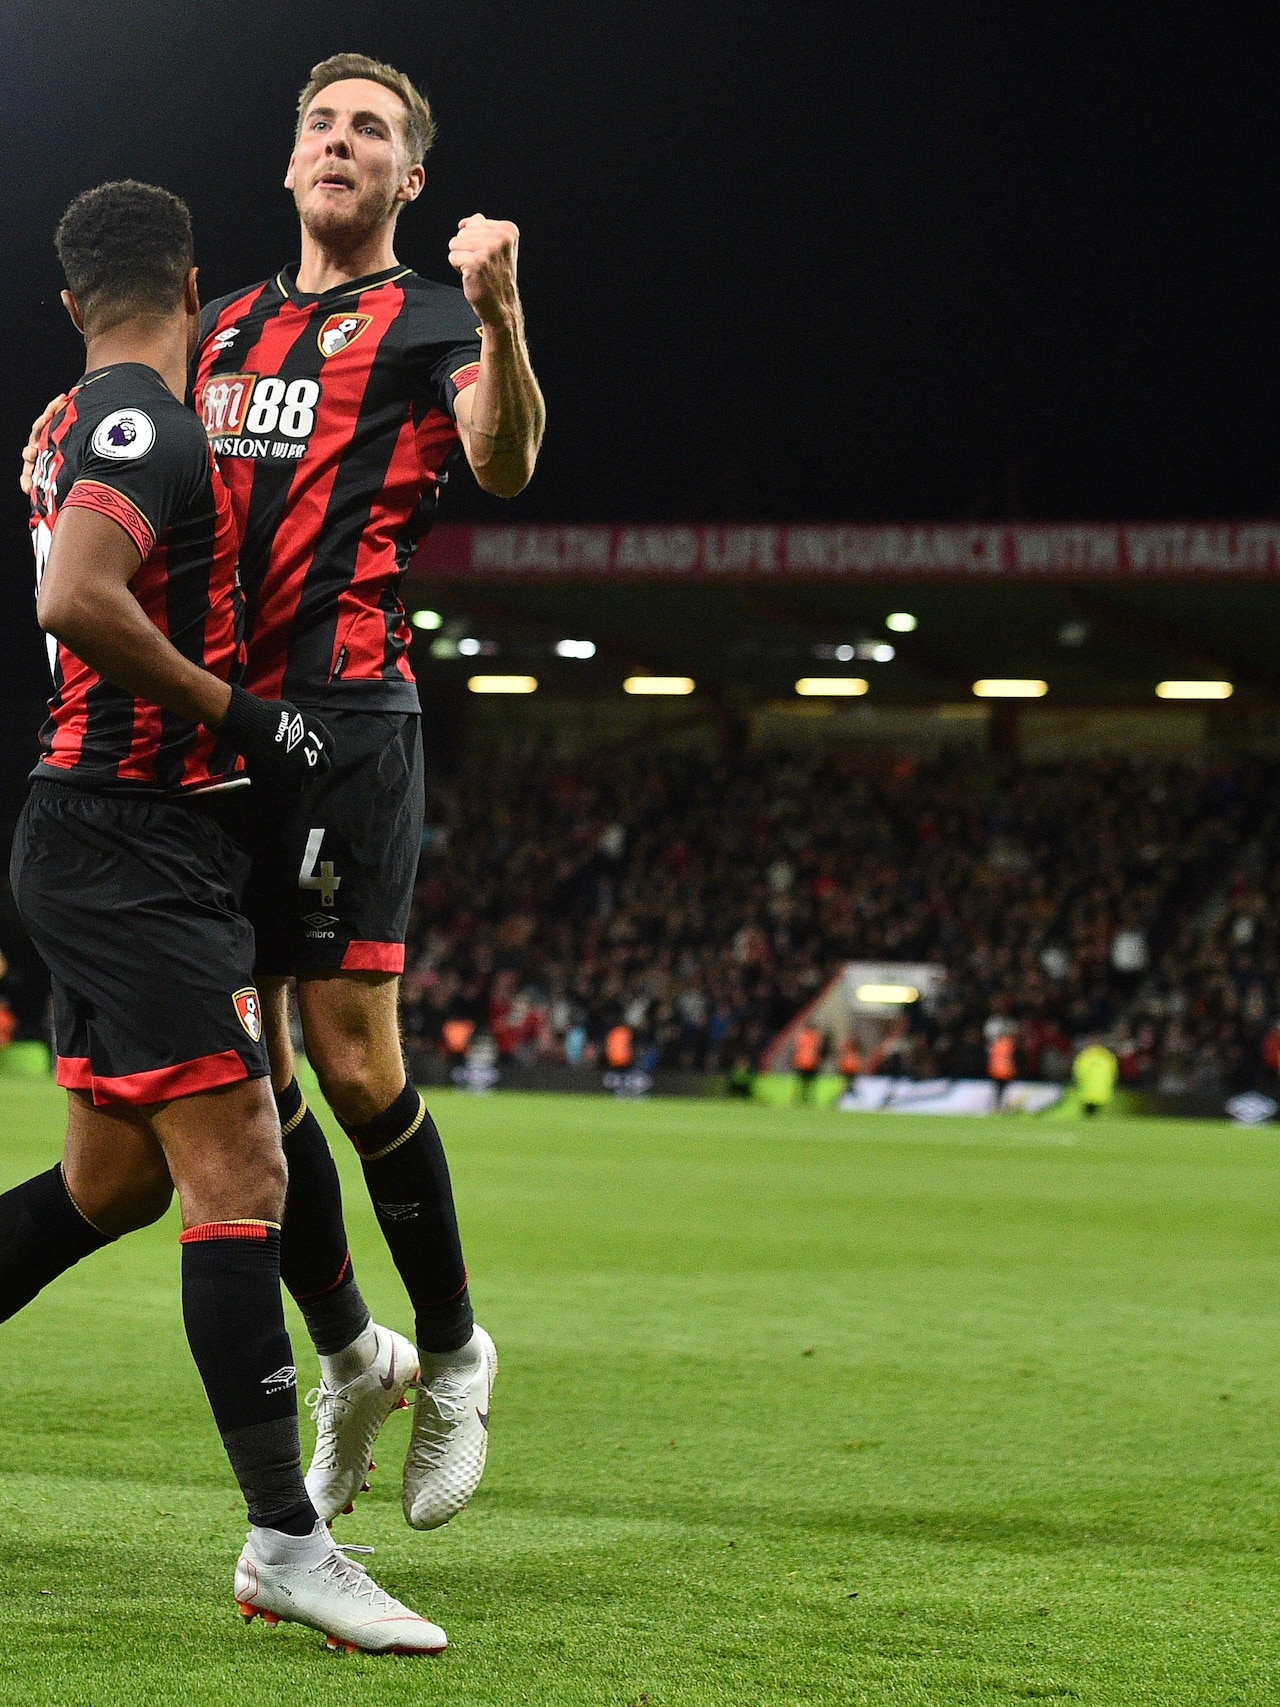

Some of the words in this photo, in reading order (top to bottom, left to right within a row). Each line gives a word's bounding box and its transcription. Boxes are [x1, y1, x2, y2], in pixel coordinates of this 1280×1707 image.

[213, 438, 270, 457] NSION
[473, 525, 608, 573] HEALTH
[618, 525, 696, 573] AND
[704, 525, 774, 573] LIFE
[786, 525, 1007, 573] INSURANCE
[1017, 525, 1118, 573] WITH
[274, 710, 290, 742] umbro
[298, 828, 342, 907] 4
